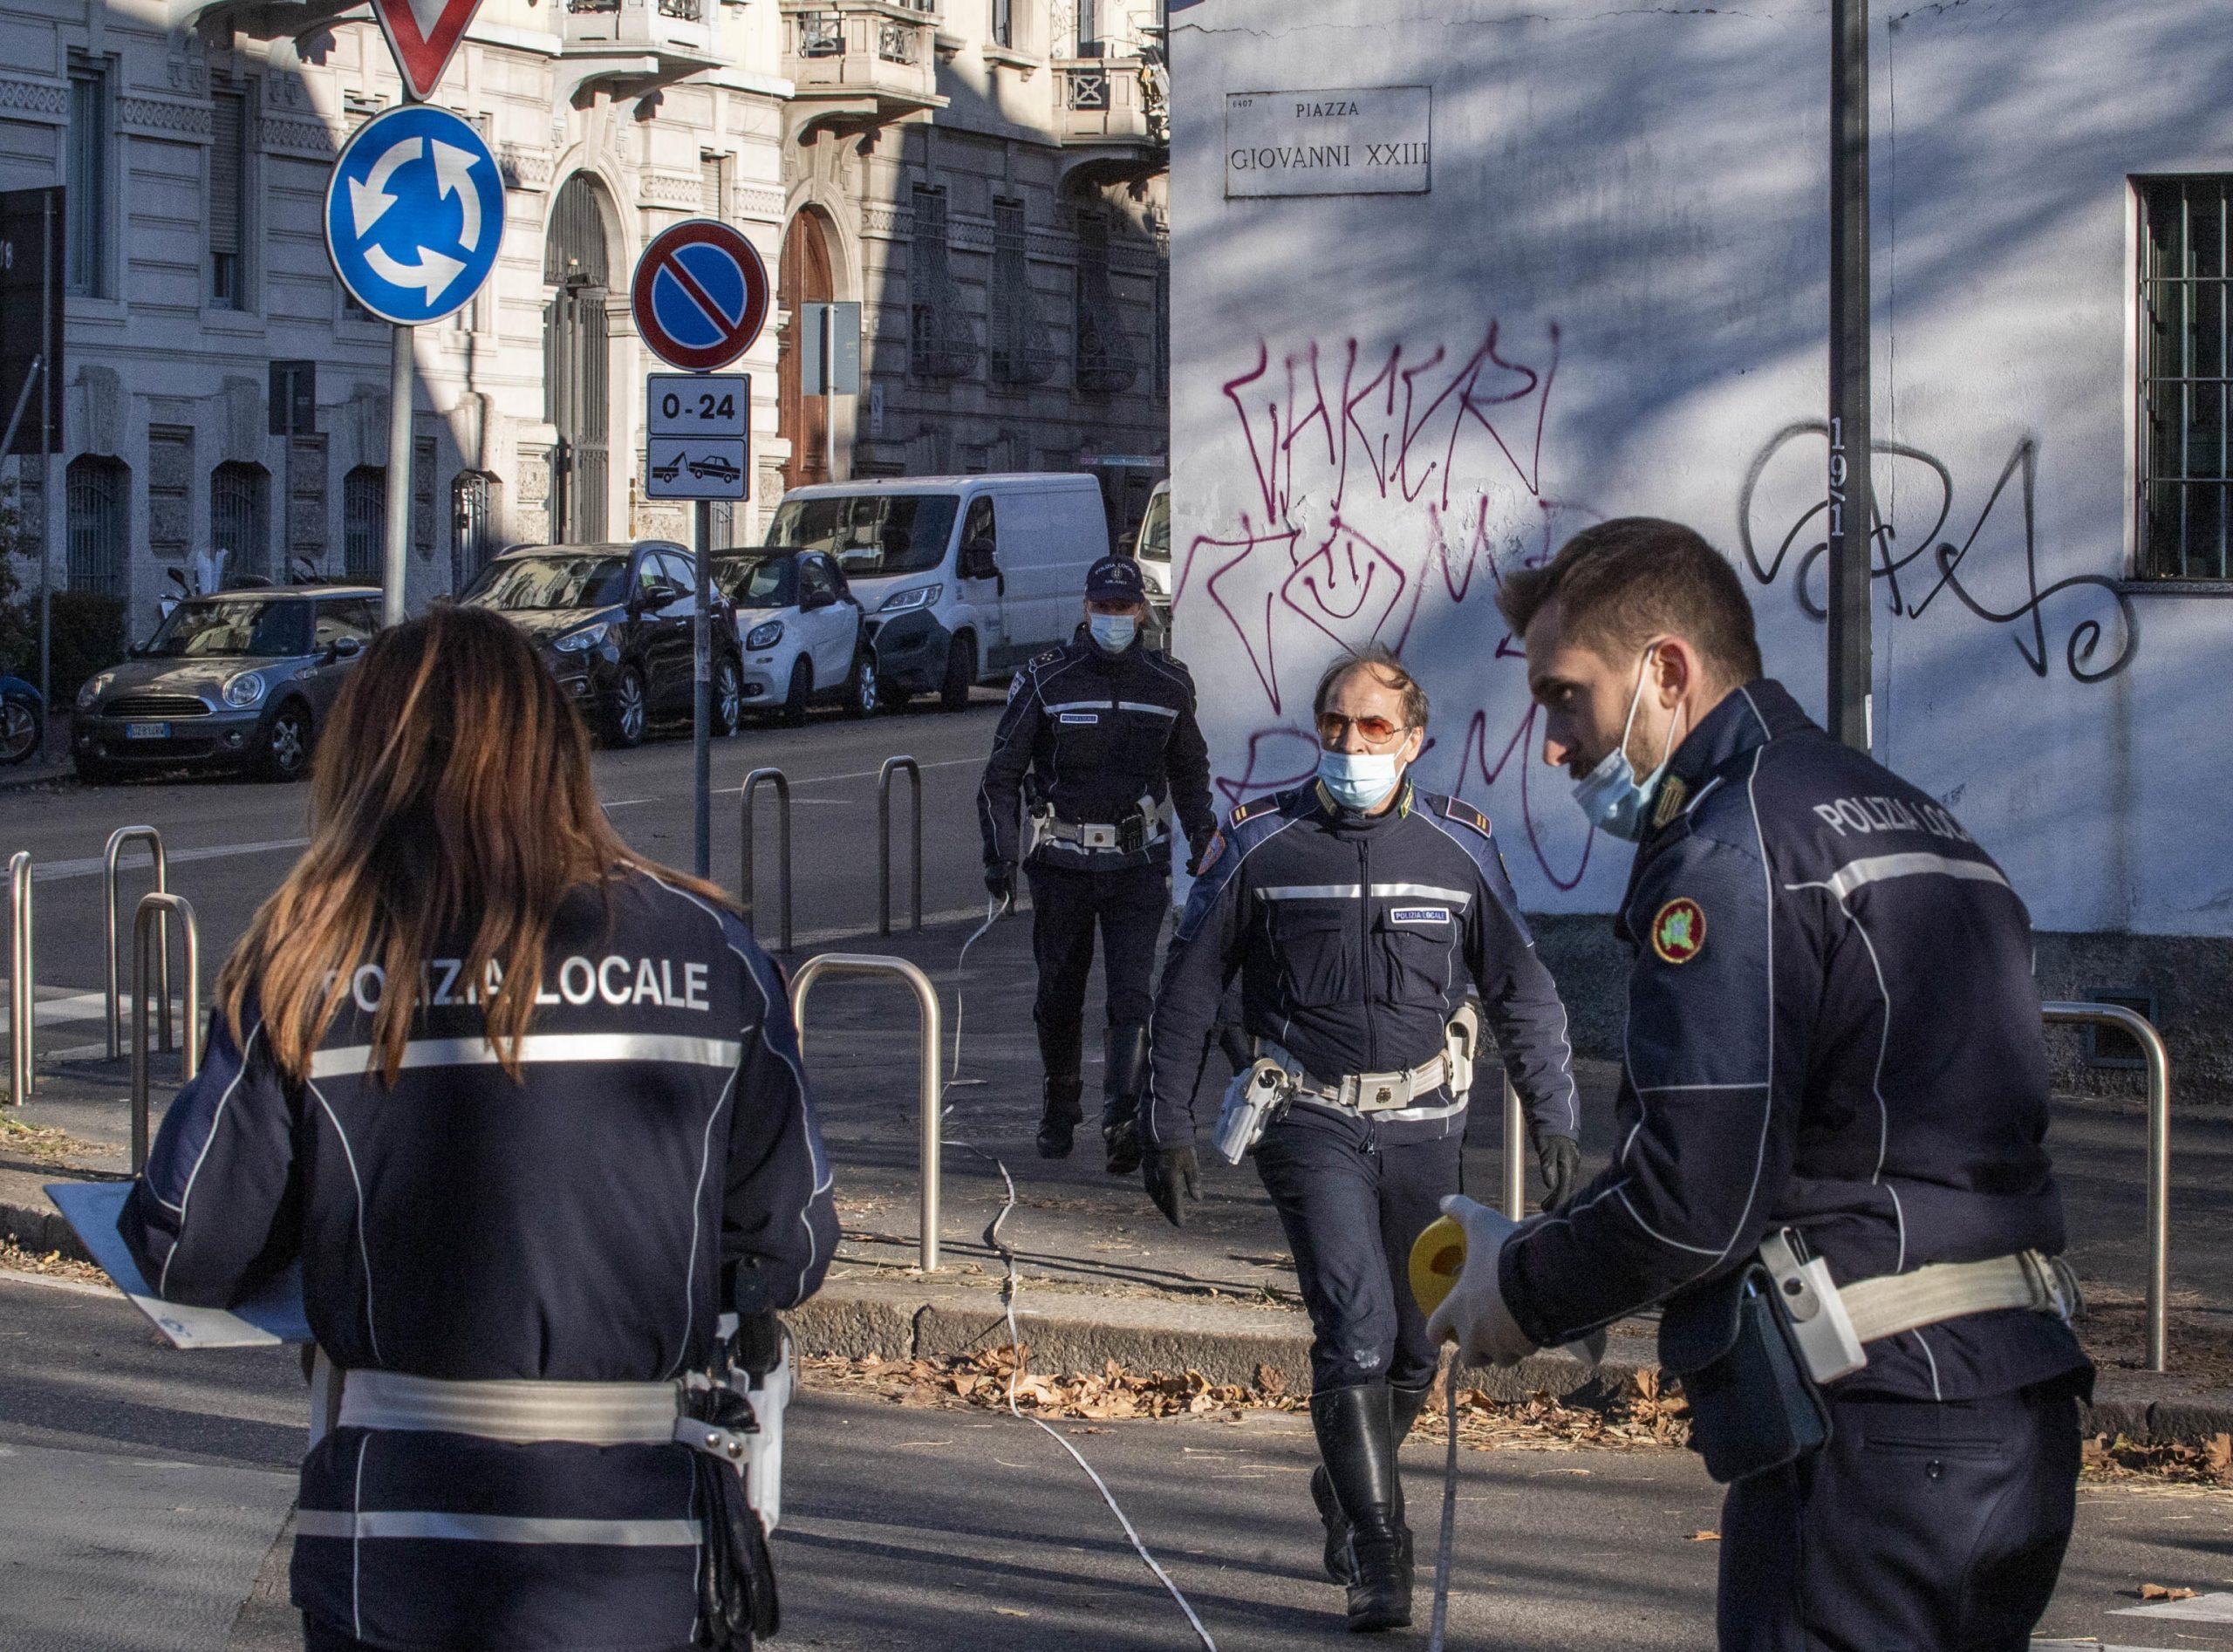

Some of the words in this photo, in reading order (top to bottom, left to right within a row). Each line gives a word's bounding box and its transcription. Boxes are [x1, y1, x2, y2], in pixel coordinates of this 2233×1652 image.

[1296, 101, 1359, 118] PIAZZA
[1231, 144, 1350, 170] GIOVANNI
[1365, 142, 1428, 166] XXIII
[1813, 796, 1925, 837] POLIZIA
[1423, 911, 1445, 920] LOCALE
[535, 956, 710, 1011] LOCALE
